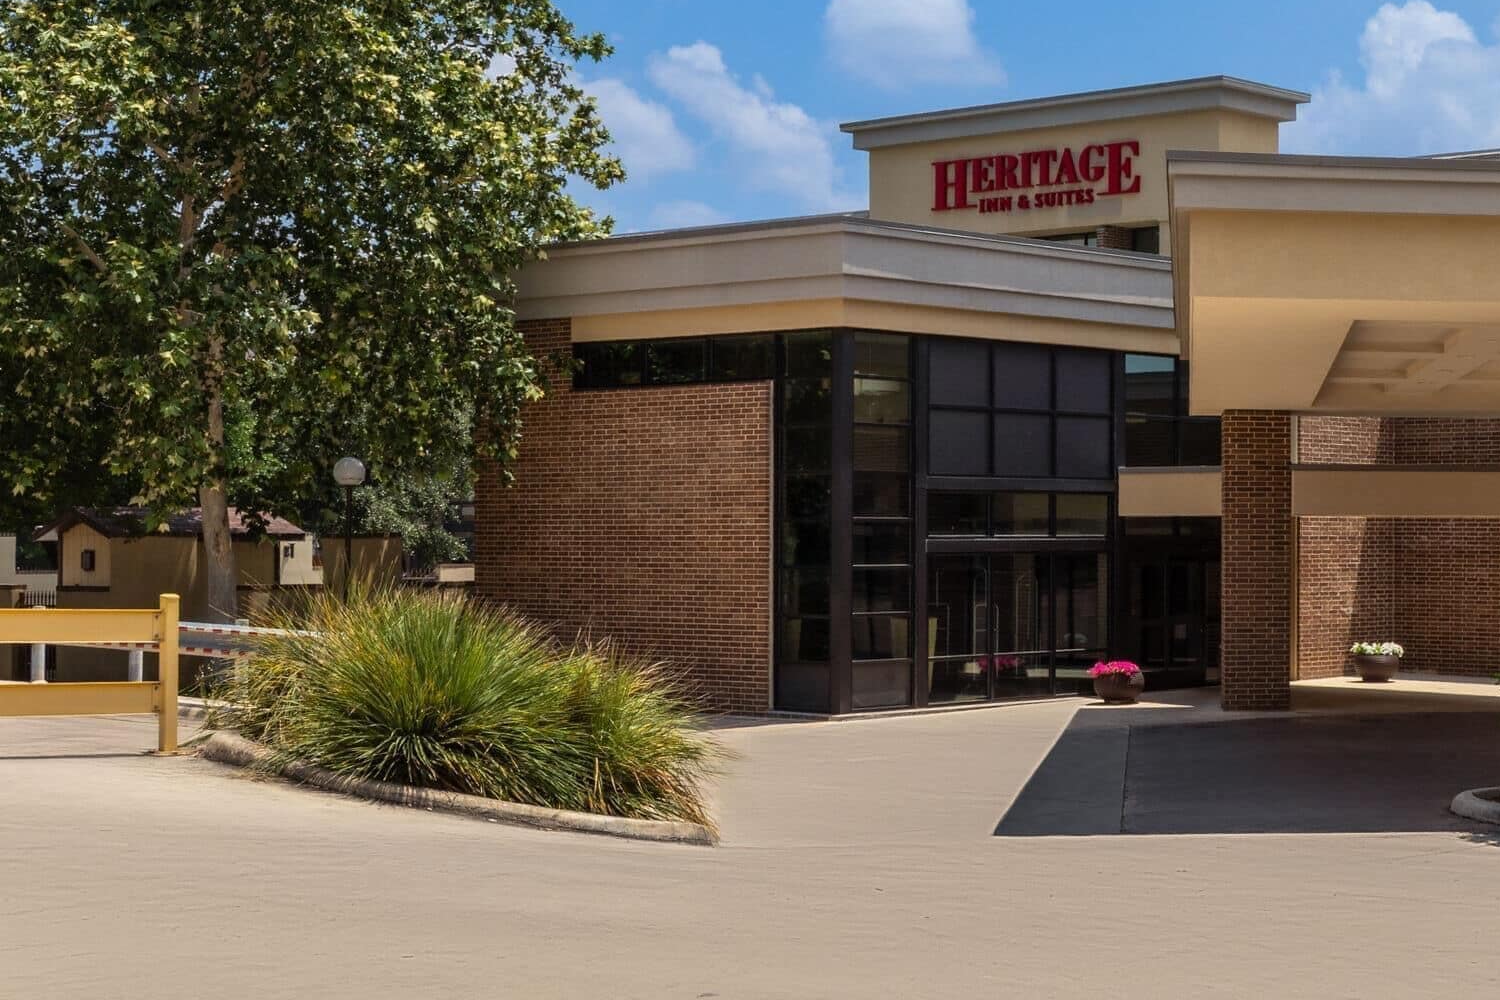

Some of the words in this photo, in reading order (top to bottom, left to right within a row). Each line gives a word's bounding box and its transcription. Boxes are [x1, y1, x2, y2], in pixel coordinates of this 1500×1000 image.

[931, 140, 1141, 212] HERITAGE
[978, 196, 1013, 213] INN
[1017, 194, 1030, 209] &
[1034, 188, 1095, 209] SUITES
